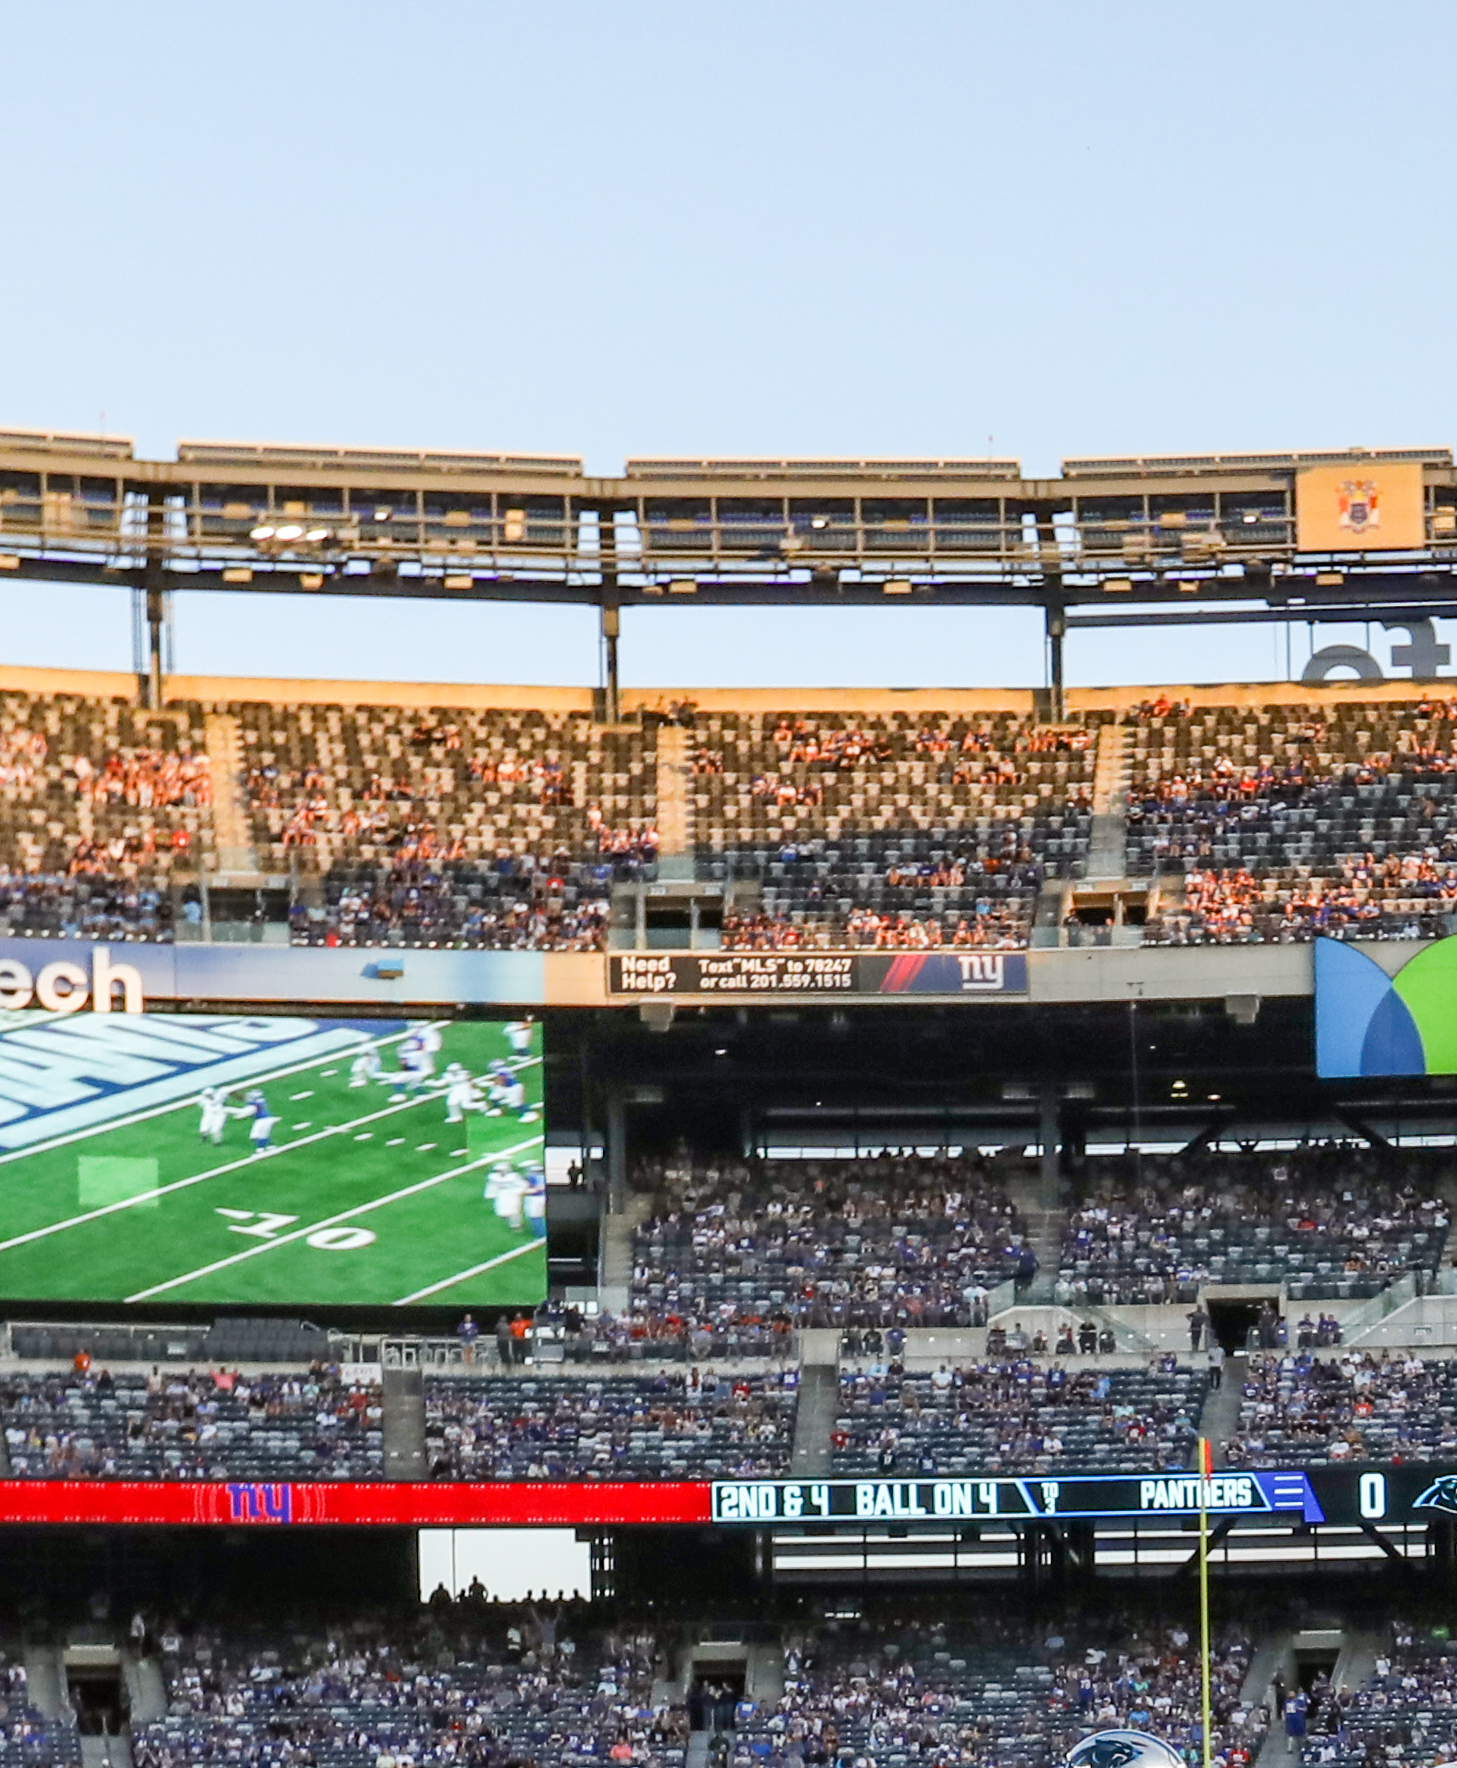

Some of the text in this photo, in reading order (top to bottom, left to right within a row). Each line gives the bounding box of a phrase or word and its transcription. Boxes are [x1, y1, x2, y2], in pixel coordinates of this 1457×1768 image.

[622, 956, 670, 973] Need
[698, 958, 733, 974] Text
[787, 960, 803, 974] to
[805, 958, 852, 973] 78247
[622, 972, 852, 990] Help? or call 201.559.1515
[1042, 1482, 1059, 1499] TO
[1141, 1477, 1252, 1510] PANTHERS
[1359, 1471, 1387, 1519] 0
[720, 1483, 777, 1518] 2ND
[783, 1485, 803, 1515] &
[810, 1484, 829, 1515] 4
[855, 1483, 924, 1517] BALL
[934, 1483, 967, 1515] ON
[980, 1483, 996, 1515] 4
[1045, 1500, 1055, 1516] 3
